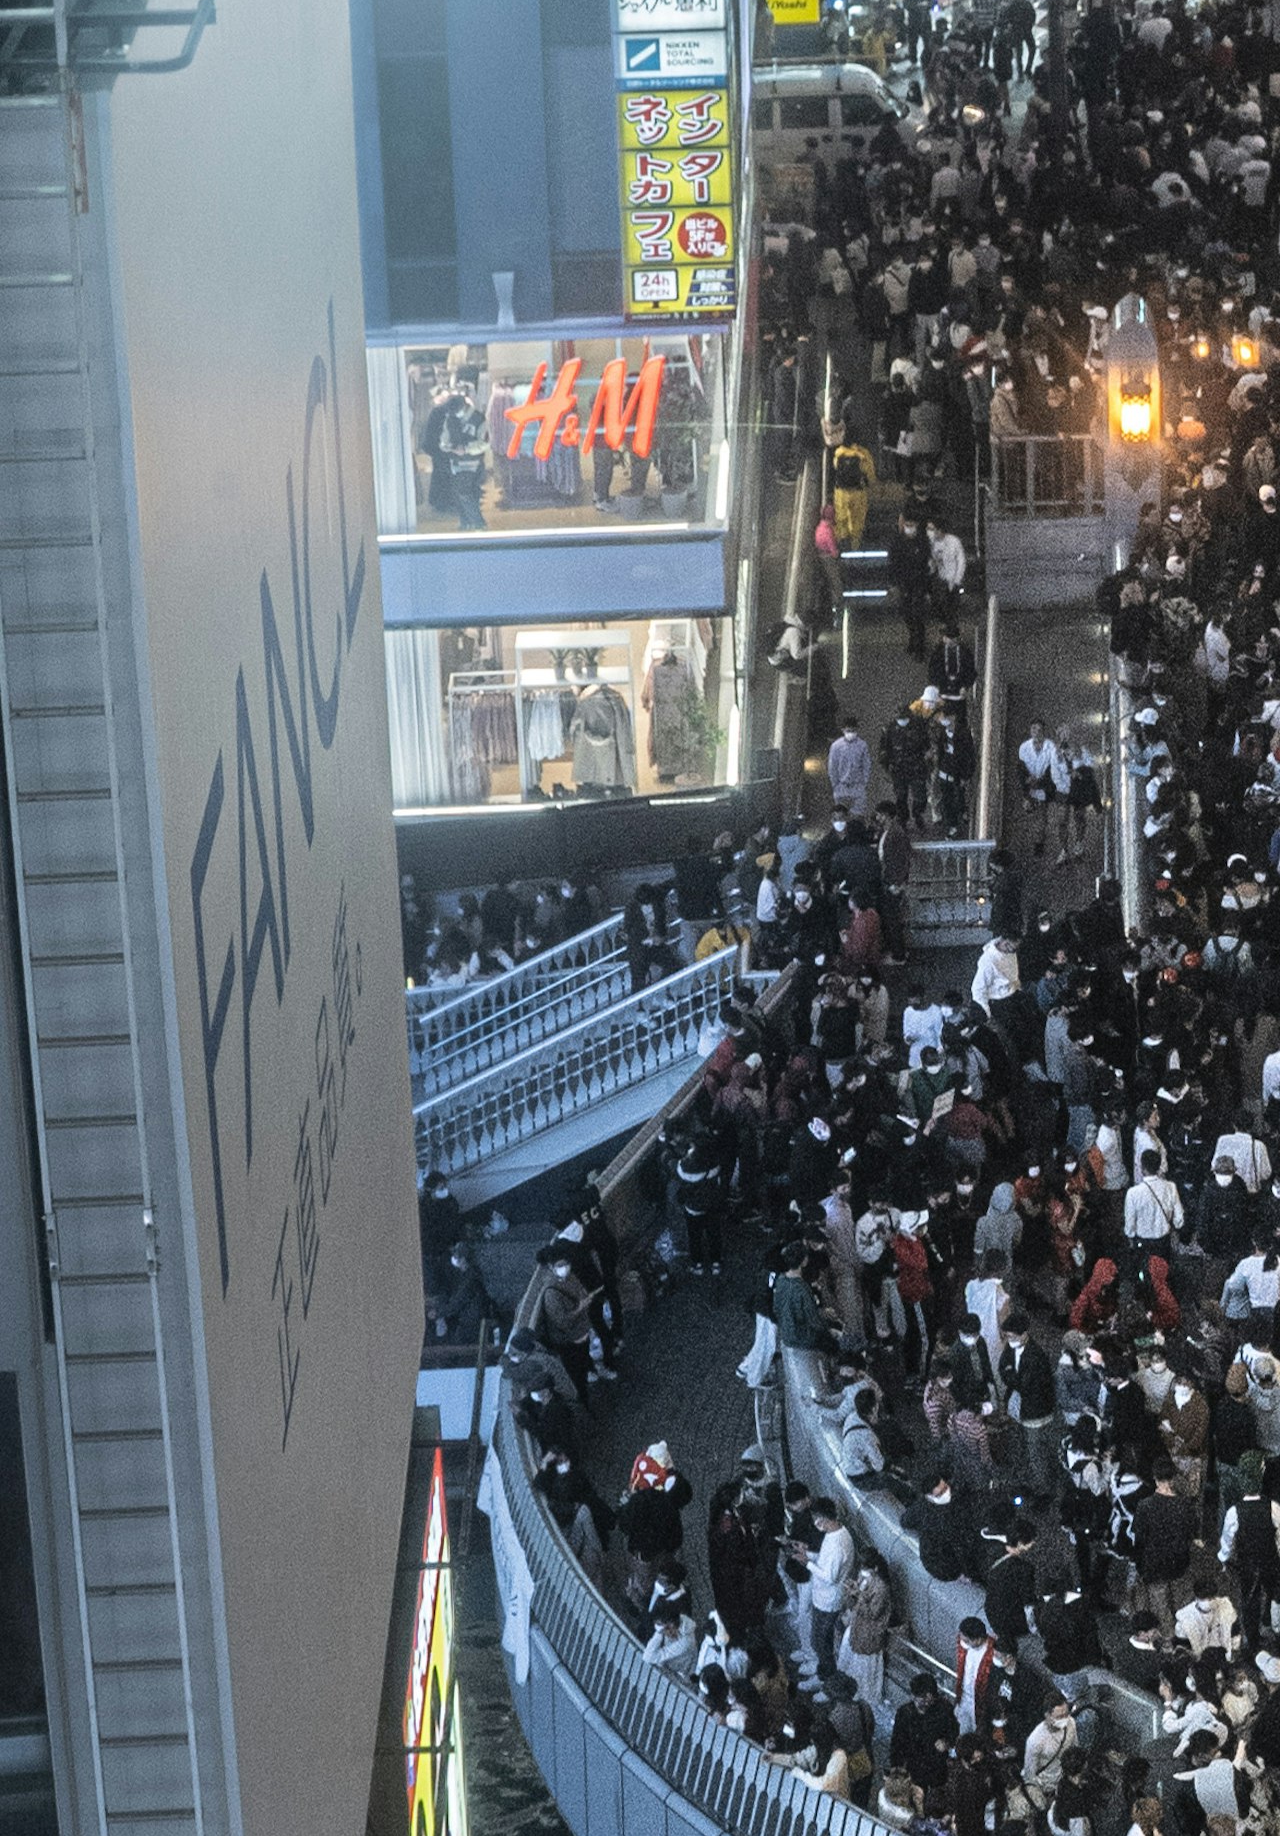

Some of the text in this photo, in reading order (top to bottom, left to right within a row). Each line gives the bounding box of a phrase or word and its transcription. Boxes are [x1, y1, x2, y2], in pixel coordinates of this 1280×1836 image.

[624, 93, 674, 262] ネットカフェ
[677, 93, 723, 203] インター
[640, 273, 671, 287] 24h
[640, 288, 670, 298] OPEN
[505, 354, 665, 461] H&M
[190, 295, 366, 1301] FANCL
